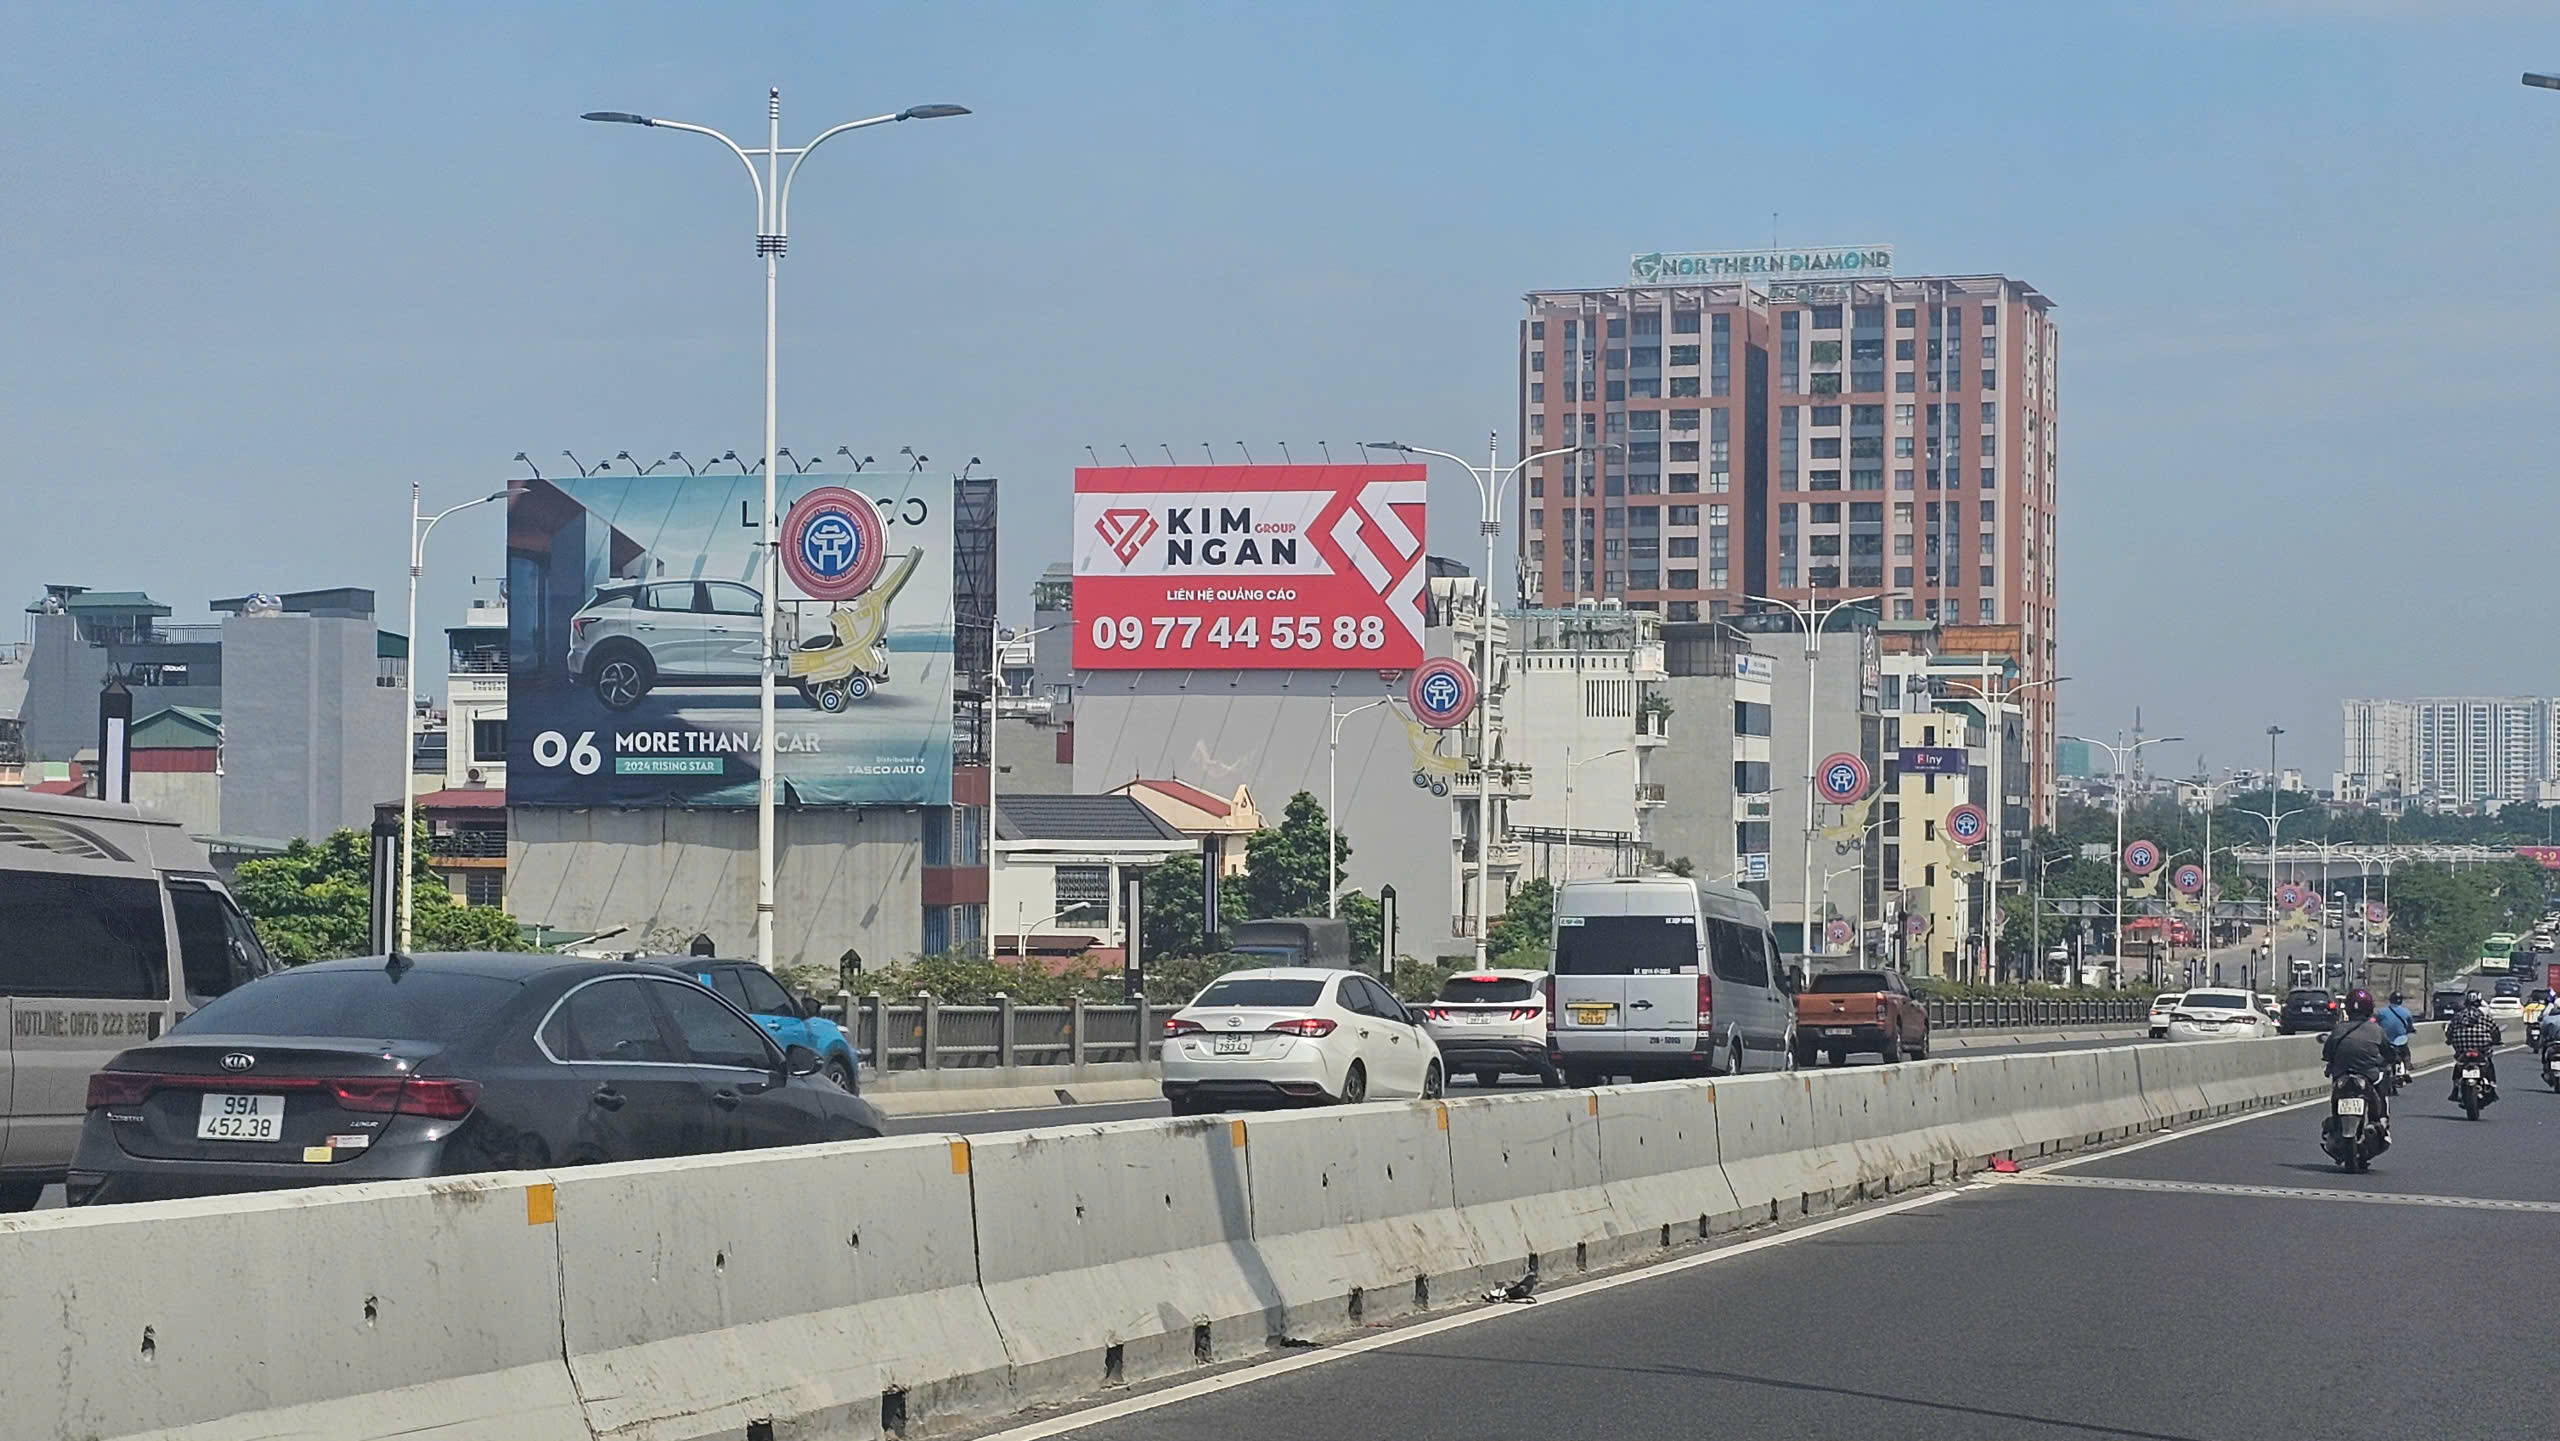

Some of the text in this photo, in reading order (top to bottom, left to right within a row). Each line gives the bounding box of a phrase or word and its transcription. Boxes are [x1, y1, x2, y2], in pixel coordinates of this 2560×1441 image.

[1662, 251, 1890, 276] NORTHERN DIAMOND
[1167, 507, 1296, 535] KIM GROUP
[1167, 538, 1297, 566] NGAN
[1166, 586, 1296, 603] LIÊN HỆ QUẢNG CÁO
[1092, 616, 1143, 649] 09
[1270, 616, 1322, 649] 55
[1332, 615, 1385, 649] 88
[615, 731, 679, 753] MORE
[685, 731, 748, 753] THAN
[775, 732, 821, 753] CAR
[533, 731, 602, 775] 06
[876, 756, 915, 764] Distributed
[624, 761, 714, 771] 2024 RISING STAR
[848, 765, 926, 775] TASCO AUTO
[14, 1010, 68, 1036] HOTLINE:
[102, 1011, 123, 1036] 222
[225, 1056, 248, 1068] KIA
[224, 1096, 258, 1115] 99A
[207, 1117, 271, 1137] 452.38
